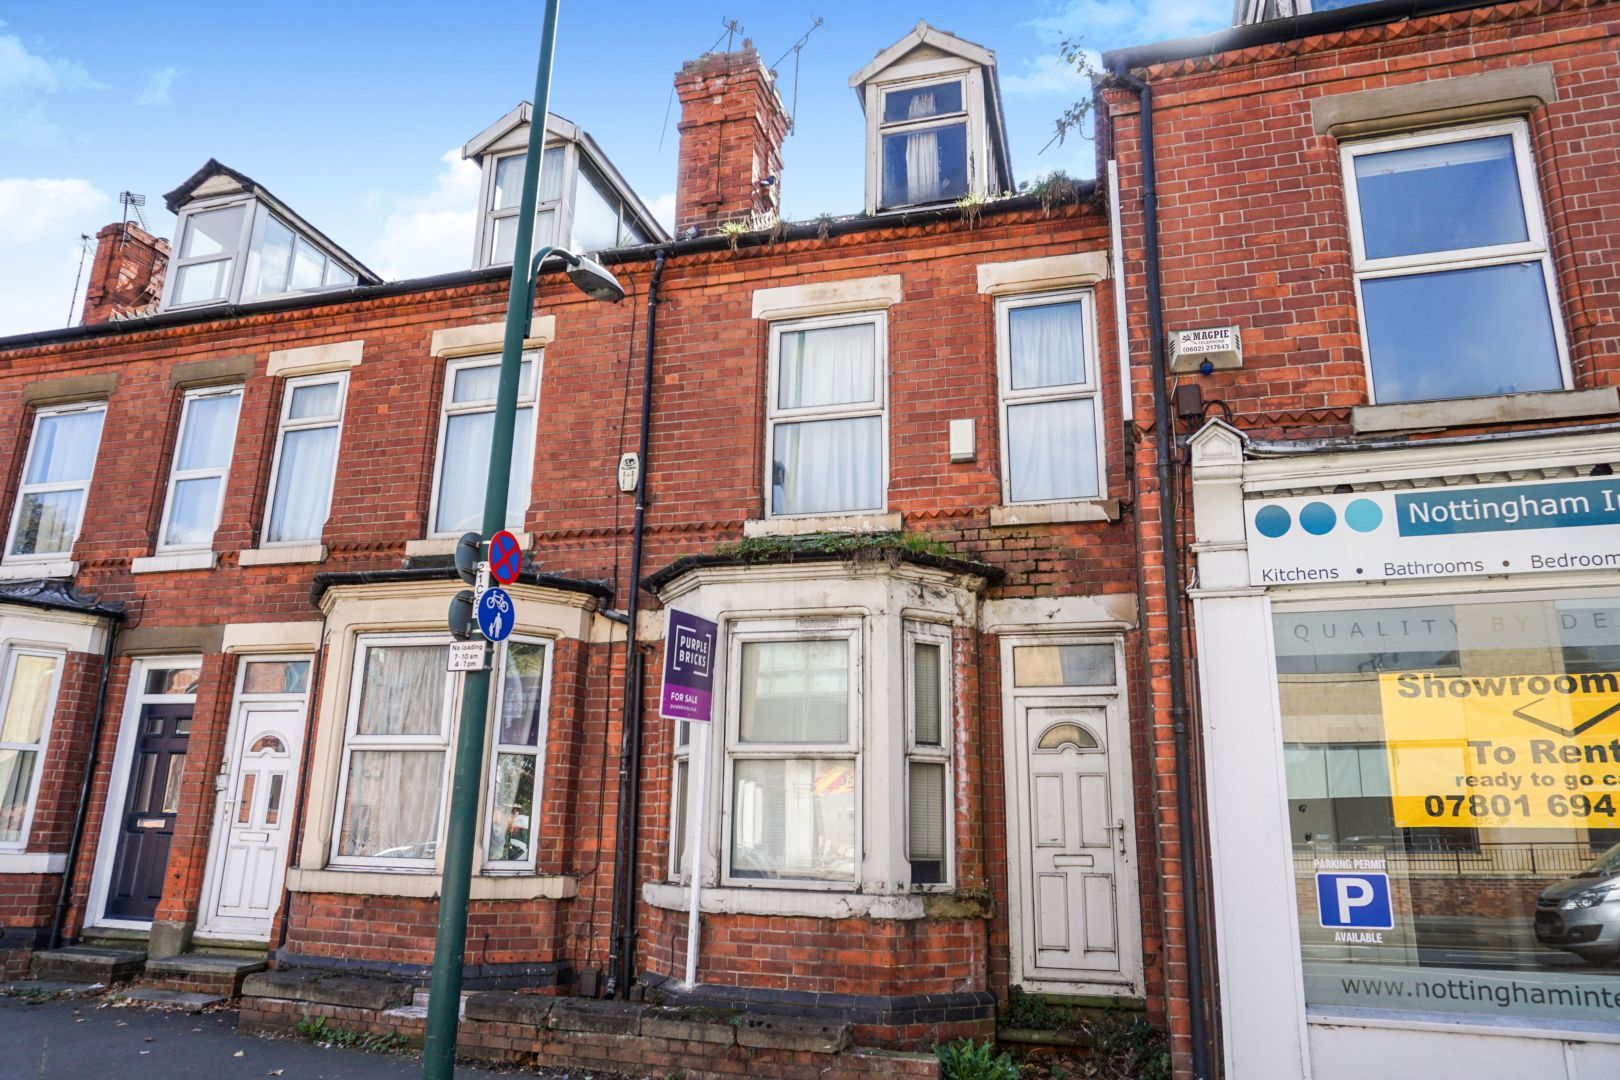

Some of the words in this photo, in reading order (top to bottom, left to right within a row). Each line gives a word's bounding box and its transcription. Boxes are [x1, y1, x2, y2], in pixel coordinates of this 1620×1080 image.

[1193, 330, 1229, 340] MAGPIE
[1408, 494, 1590, 524] Nottingham
[1601, 489, 1620, 512] I
[1261, 565, 1340, 582] Kitchens
[1383, 559, 1485, 577] Bathrooms
[1294, 619, 1459, 642] QUALITY
[461, 642, 483, 651] loading
[680, 635, 707, 653] PURPLE
[679, 650, 706, 667] BRICKS
[1398, 672, 1619, 698] Showroom
[670, 691, 684, 702] FOR
[684, 694, 698, 704] SALE
[1467, 740, 1516, 765] To
[1530, 739, 1620, 764] Rent
[1455, 772, 1522, 791] ready
[1530, 772, 1555, 787] to
[1564, 774, 1594, 790] go
[1603, 774, 1620, 786] c
[1425, 794, 1531, 817] 07801
[1547, 794, 1616, 818] 694
[1314, 859, 1352, 869] PARKING
[1353, 859, 1387, 869] PERMIT
[1335, 877, 1375, 924] P
[1334, 932, 1383, 943] AVAILABLE
